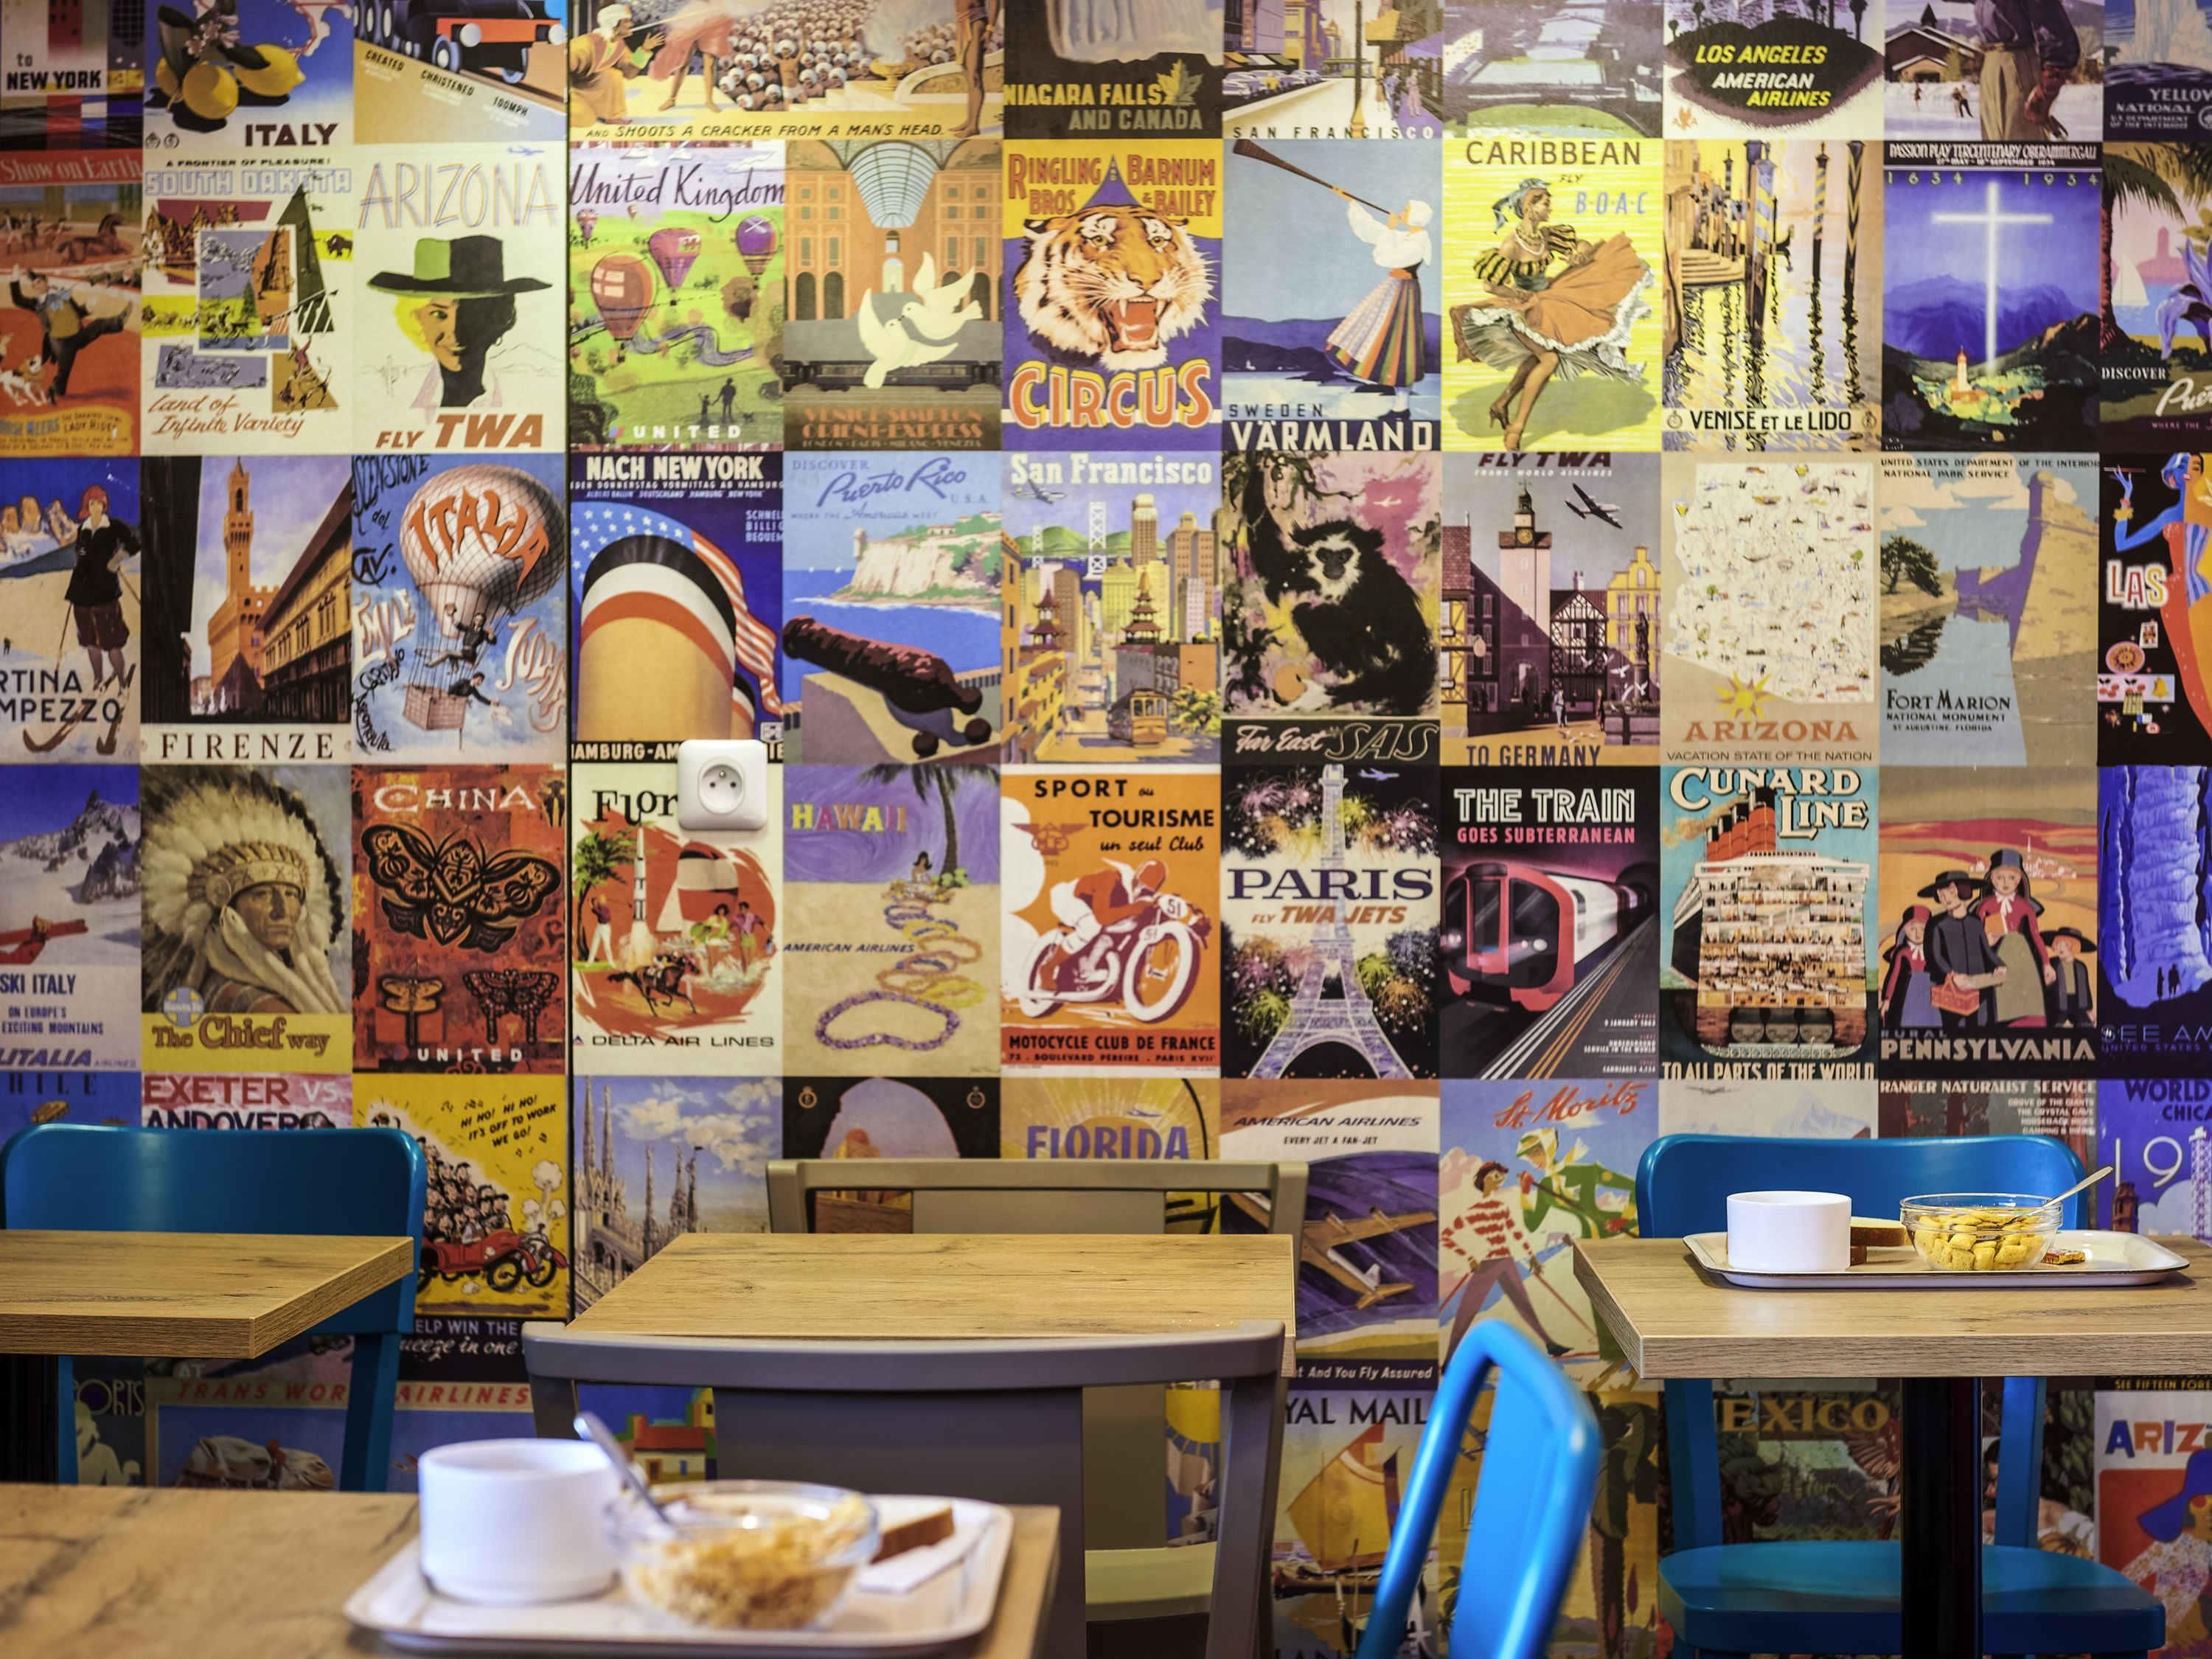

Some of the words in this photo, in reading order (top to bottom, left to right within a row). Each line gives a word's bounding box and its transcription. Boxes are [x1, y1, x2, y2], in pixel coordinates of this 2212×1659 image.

[365, 49, 405, 72] CREATED
[1695, 45, 1735, 64] LOS
[1737, 44, 1827, 64] ANGELES
[6, 72, 48, 91] NEW
[49, 70, 102, 89] YORK
[420, 69, 476, 97] CHRISTENED
[1711, 72, 1815, 90] AMERICAN
[1004, 83, 1095, 106] NIAGARA
[1100, 83, 1164, 106] FALLS
[1746, 90, 1831, 108] AIRLINES
[493, 96, 529, 117] 100MPH
[2116, 103, 2196, 114] NATIONAL
[1068, 109, 1111, 131] AND
[1119, 109, 1203, 131] CANADA
[245, 123, 339, 147] ITALY
[585, 129, 609, 138] AND
[615, 125, 675, 138] SHOOTS
[700, 125, 772, 137] CRACKER
[777, 125, 822, 137] FROM
[1232, 126, 1277, 139] SAN
[1293, 126, 1434, 140] FRANCISCO
[1466, 140, 1641, 166] CARIBBEAN
[1, 155, 55, 182] Show
[56, 161, 82, 181] on
[86, 154, 142, 180] Earth
[1008, 153, 1102, 200] RINGLING
[1127, 153, 1216, 186] BARNUM
[1559, 173, 1585, 184] FLY
[144, 169, 233, 196] SOUTH
[240, 167, 352, 195] DAKOTA
[570, 162, 665, 207] United
[673, 161, 785, 223] Kingdom
[358, 161, 559, 229] ARIZONA
[1029, 189, 1077, 215] BROS
[1154, 189, 1217, 217] BAILEY
[2101, 366, 2166, 380] DISCOVER
[148, 393, 203, 415] Land
[1008, 358, 1213, 429] CIRCUS
[1228, 403, 1324, 418] SWEDEN
[1690, 410, 1756, 431] VENISE
[1761, 417, 1779, 431] ET
[1784, 417, 1804, 431] LE
[1808, 410, 1852, 431] LIDO
[150, 414, 229, 440] Infinite
[232, 411, 306, 438] Variety
[375, 430, 425, 450] FLY
[432, 414, 544, 450] TWA
[633, 425, 742, 439] UNITED
[1230, 419, 1434, 451] VÄRMLAND
[586, 455, 645, 480] NACH
[653, 455, 703, 480] NEW
[704, 455, 764, 480] YORK
[792, 459, 869, 471] DISCOVER
[1010, 453, 1063, 484] San
[1071, 453, 1213, 484] Francisco
[1478, 451, 1528, 467] FLY
[1536, 451, 1612, 467] TWA
[1881, 459, 1912, 467] UNITED
[1917, 459, 1949, 467] STATES
[1955, 459, 2014, 467] DEPARTMENT
[597, 481, 658, 490] DONNERSTAG
[816, 469, 904, 508] Puerto
[905, 456, 967, 500] Rico
[1884, 470, 1932, 479] NATIONAL
[1937, 470, 1964, 479] PARK
[1968, 470, 2010, 479] SERVICE
[408, 485, 550, 591] ITALIA
[2107, 560, 2169, 609] LAS
[1886, 688, 1933, 711] FORT
[1936, 688, 2011, 711] MARION
[1886, 712, 1937, 721] NATIONAL
[1941, 712, 2006, 722] MONUMENT
[1955, 724, 1993, 732] FLORIDA
[1275, 725, 1328, 754] East
[1327, 722, 1440, 762] SAS
[1682, 720, 1860, 742] ARIZONA
[160, 732, 334, 760] FIRENZE
[1466, 745, 1494, 767] TO
[1500, 745, 1601, 767] GERMANY
[1667, 751, 1730, 762] VACATION
[1733, 751, 1770, 762] STATE
[1775, 751, 1793, 762] OF
[1798, 751, 1821, 762] THE
[1825, 751, 1872, 762] NATION
[374, 783, 539, 813] CHINA
[1034, 779, 1128, 798] SPORT
[1669, 765, 1863, 812] CUNARD
[1453, 787, 1523, 823] THE
[1531, 787, 1636, 824] TRAIN
[791, 803, 908, 832] HAWAII
[1089, 809, 1215, 828] TOURISME
[1778, 794, 1869, 841] LINE
[1099, 842, 1121, 852] un
[1128, 836, 1162, 852] seul
[1169, 835, 1204, 852] Club
[1456, 826, 1498, 844] GOES
[1505, 826, 1636, 845] SUBTERRANEAN
[1227, 867, 1434, 900] PARIS
[1251, 914, 1276, 925] FLY
[1280, 905, 1339, 925] TWA
[1343, 905, 1408, 925] JETS
[783, 943, 852, 953] AMERICAN
[856, 943, 915, 953] AIRLINES
[0, 973, 26, 995] SKI
[32, 973, 77, 995] ITALY
[1, 1021, 44, 1034] EXCITING
[49, 1022, 104, 1035] MOUNTAINS
[152, 1027, 194, 1048] The
[198, 1015, 287, 1050] Chief
[287, 1034, 331, 1056] way
[2101, 1024, 2160, 1043] SEE
[592, 1034, 656, 1047] DELTA
[663, 1034, 700, 1047] AIR
[710, 1034, 775, 1048] LINES
[1009, 1035, 1088, 1050] MOTOCYCLE
[1095, 1035, 1130, 1050] CLUB
[1137, 1035, 1155, 1050] DE
[1161, 1036, 1216, 1051] FRANCE
[1880, 1037, 2096, 1061] PENNSYLVANIA
[417, 1048, 524, 1062] UNITED
[1034, 1053, 1095, 1062] BOULEVARD
[1661, 1061, 1683, 1079] TO
[1713, 1062, 1762, 1080] PARTS
[1767, 1062, 1786, 1080] OF
[1789, 1062, 1817, 1080] THE
[1820, 1062, 1876, 1080] WORLD
[143, 1077, 290, 1105] EXETER
[1880, 1080, 1938, 1094] RANGER
[1941, 1080, 2027, 1094] NATURALIST
[2033, 1080, 2096, 1094] SERVICE
[2124, 1079, 2211, 1103] WORLD
[1534, 1081, 1649, 1124] Moritz
[1234, 1116, 1335, 1127] AMERICAN
[1338, 1117, 1422, 1127] AIRLINES
[1026, 1124, 1190, 1159] FLORIDA
[1284, 1135, 1311, 1145] EVERY
[447, 1319, 479, 1335] WIN
[485, 1321, 518, 1336] THE
[459, 1335, 479, 1354] in
[483, 1340, 518, 1355] one
[1307, 1366, 1330, 1379] And
[1334, 1366, 1357, 1379] You
[1359, 1366, 1378, 1380] Fly
[1380, 1366, 1433, 1380] Assured
[178, 1380, 269, 1400] TRANS
[396, 1384, 530, 1405] AIRLINES
[1349, 1397, 1429, 1425] MAIL
